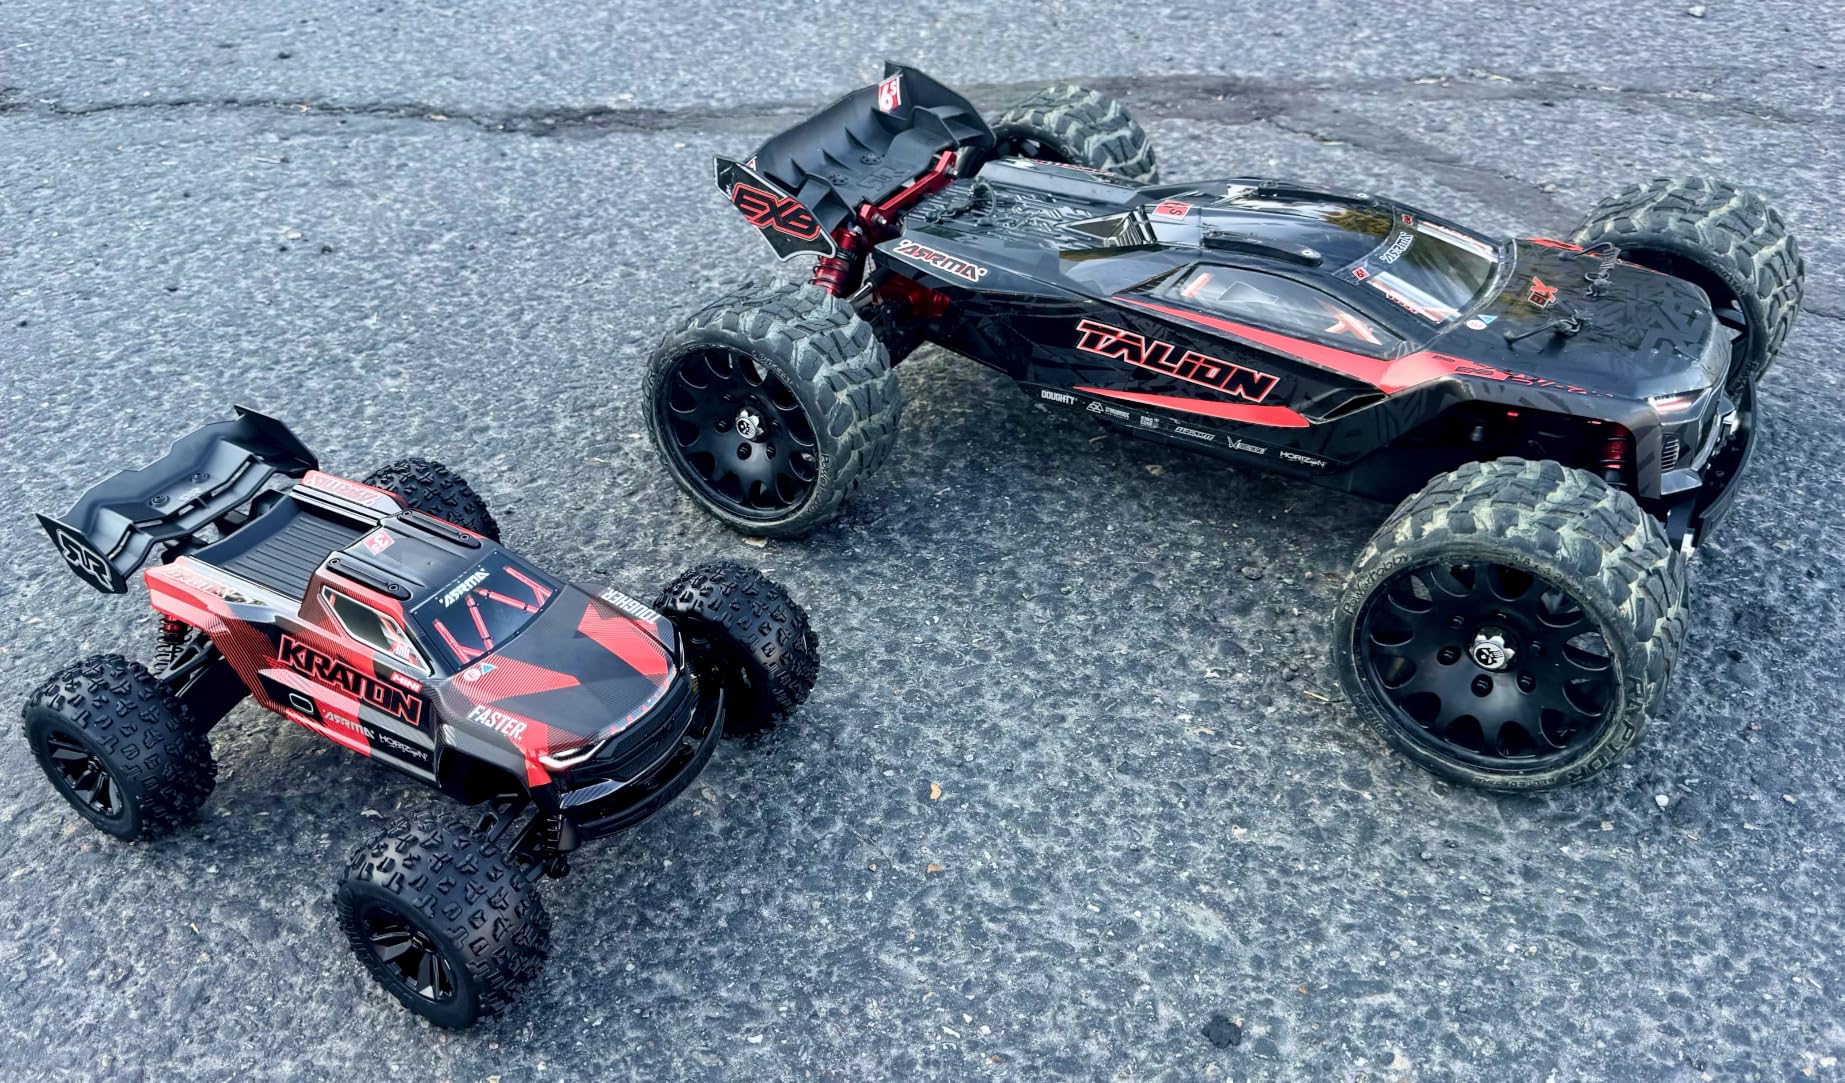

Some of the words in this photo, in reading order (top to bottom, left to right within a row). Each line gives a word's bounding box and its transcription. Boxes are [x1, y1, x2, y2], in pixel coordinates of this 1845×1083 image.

[732, 183, 821, 241] EXB
[893, 240, 987, 282] ARRMA
[1075, 318, 1280, 403] TALION
[1041, 389, 1078, 406] DOUGHTY
[1280, 450, 1327, 468] HORIZON
[438, 567, 491, 607] ARRMA
[601, 587, 662, 625] TOUGHER.
[278, 634, 422, 726] KRATON
[392, 673, 422, 693] MINI
[322, 708, 375, 740] ARRMA
[467, 704, 528, 740] FASTER.
[378, 733, 429, 762] HORIZON
